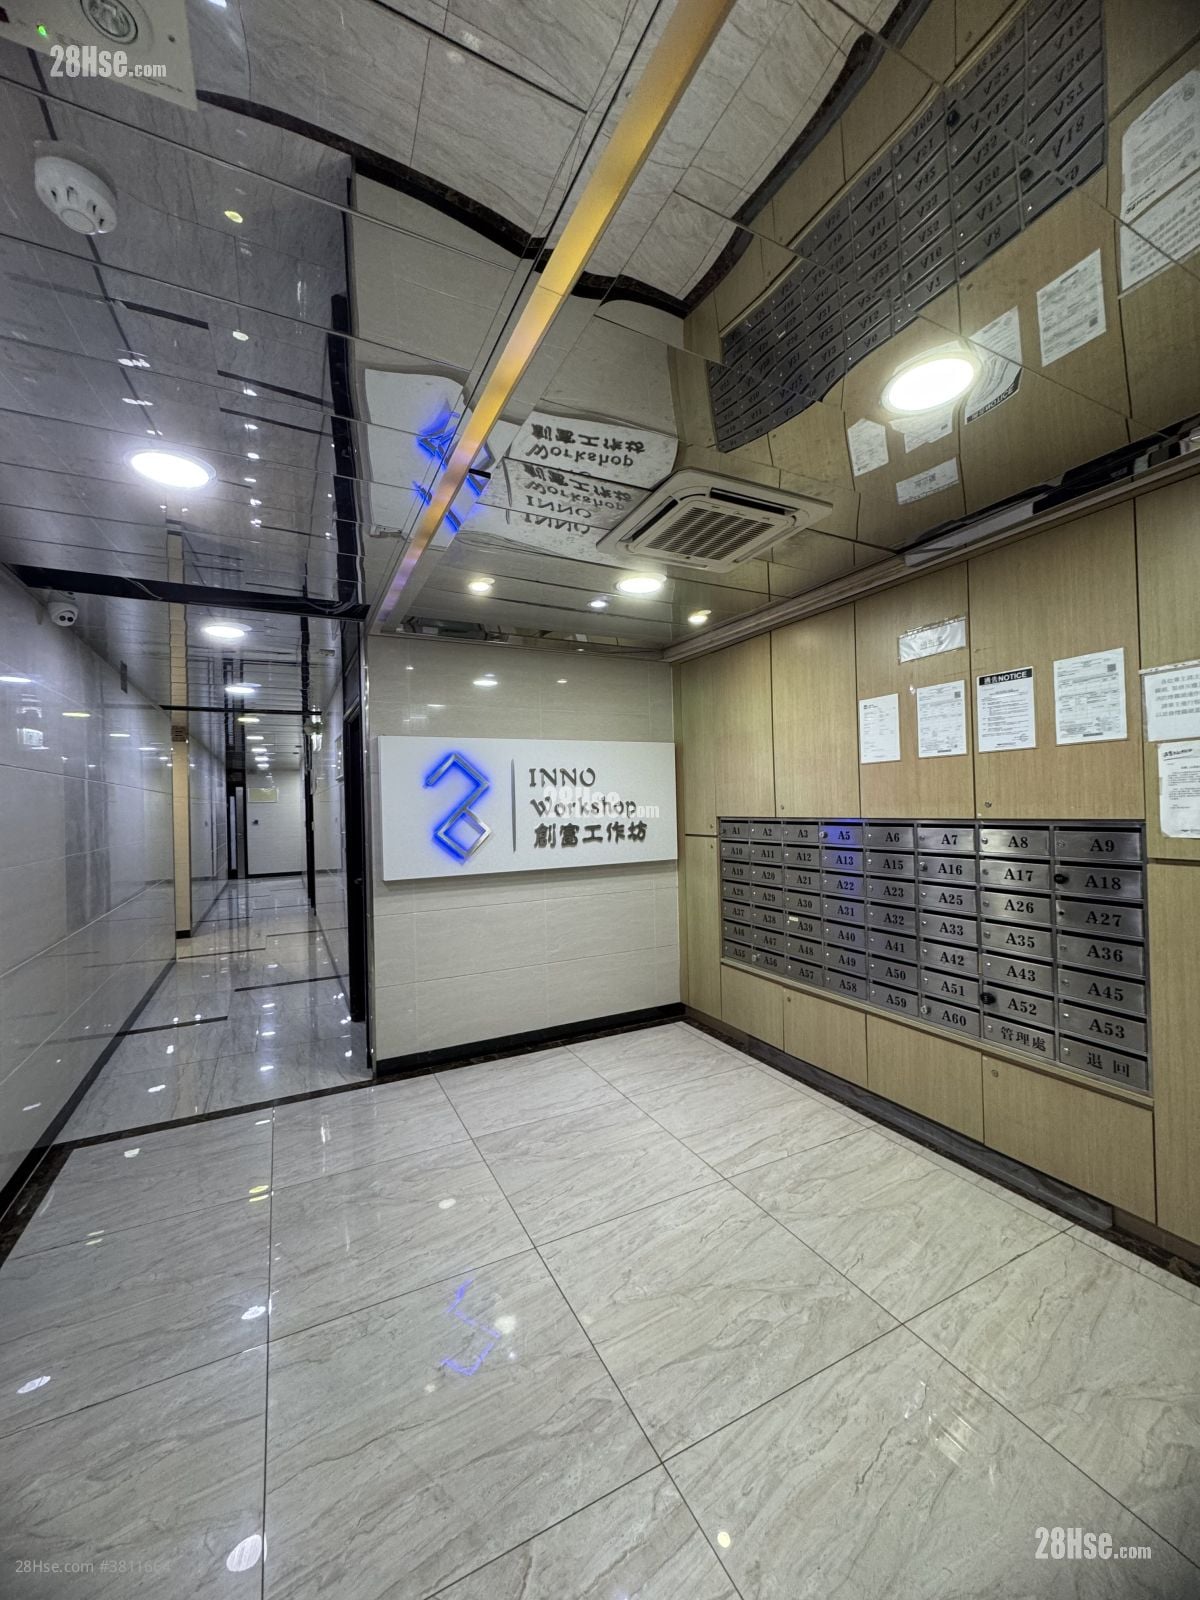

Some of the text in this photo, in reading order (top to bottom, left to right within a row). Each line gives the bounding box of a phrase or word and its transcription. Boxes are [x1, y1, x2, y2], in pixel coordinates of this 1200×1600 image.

[998, 671, 1028, 682] NOTICE
[529, 767, 596, 787] INNO
[530, 796, 636, 818] Workshop
[534, 820, 648, 848] 創富工作坊
[798, 830, 808, 838] A3
[838, 831, 850, 840] A5
[886, 832, 900, 842] A6
[941, 834, 957, 845] A7
[1008, 836, 1028, 848] A8
[1090, 839, 1114, 852] A9
[761, 850, 774, 858] A11
[796, 853, 811, 862] A12
[836, 856, 853, 865] A13
[883, 858, 903, 870] A15
[762, 871, 775, 880] A20
[938, 864, 962, 875] A16
[1004, 869, 1033, 882] A17
[797, 875, 811, 885] A21
[837, 880, 854, 891] A22
[1085, 875, 1121, 890] A18
[762, 893, 775, 902] A29
[883, 886, 904, 897] A23
[798, 898, 812, 908] A30
[939, 893, 963, 905] A25
[837, 905, 855, 917] A31
[1005, 900, 1034, 914] A26
[763, 914, 776, 924] A38
[884, 913, 904, 925] A32
[1086, 912, 1121, 927] A27
[798, 922, 812, 933] A39
[940, 923, 964, 936] A33
[763, 936, 776, 945] A47
[838, 930, 855, 942] A40
[1006, 933, 1035, 948] A35
[799, 945, 813, 956] A48
[885, 940, 904, 953] A41
[940, 952, 964, 966] A42
[1087, 945, 1122, 962] A36
[764, 958, 777, 967] A56
[839, 955, 856, 967] A49
[799, 968, 814, 979] A57
[886, 967, 906, 980] A50
[1007, 965, 1036, 981] A43
[839, 980, 856, 992] A58
[941, 982, 964, 996] A51
[1088, 983, 1123, 1001] A45
[886, 994, 906, 1007] A59
[1008, 999, 1036, 1015] A52
[942, 1011, 966, 1026] A60
[1089, 1019, 1125, 1039] A53
[1001, 1026, 1046, 1050] 管理處
